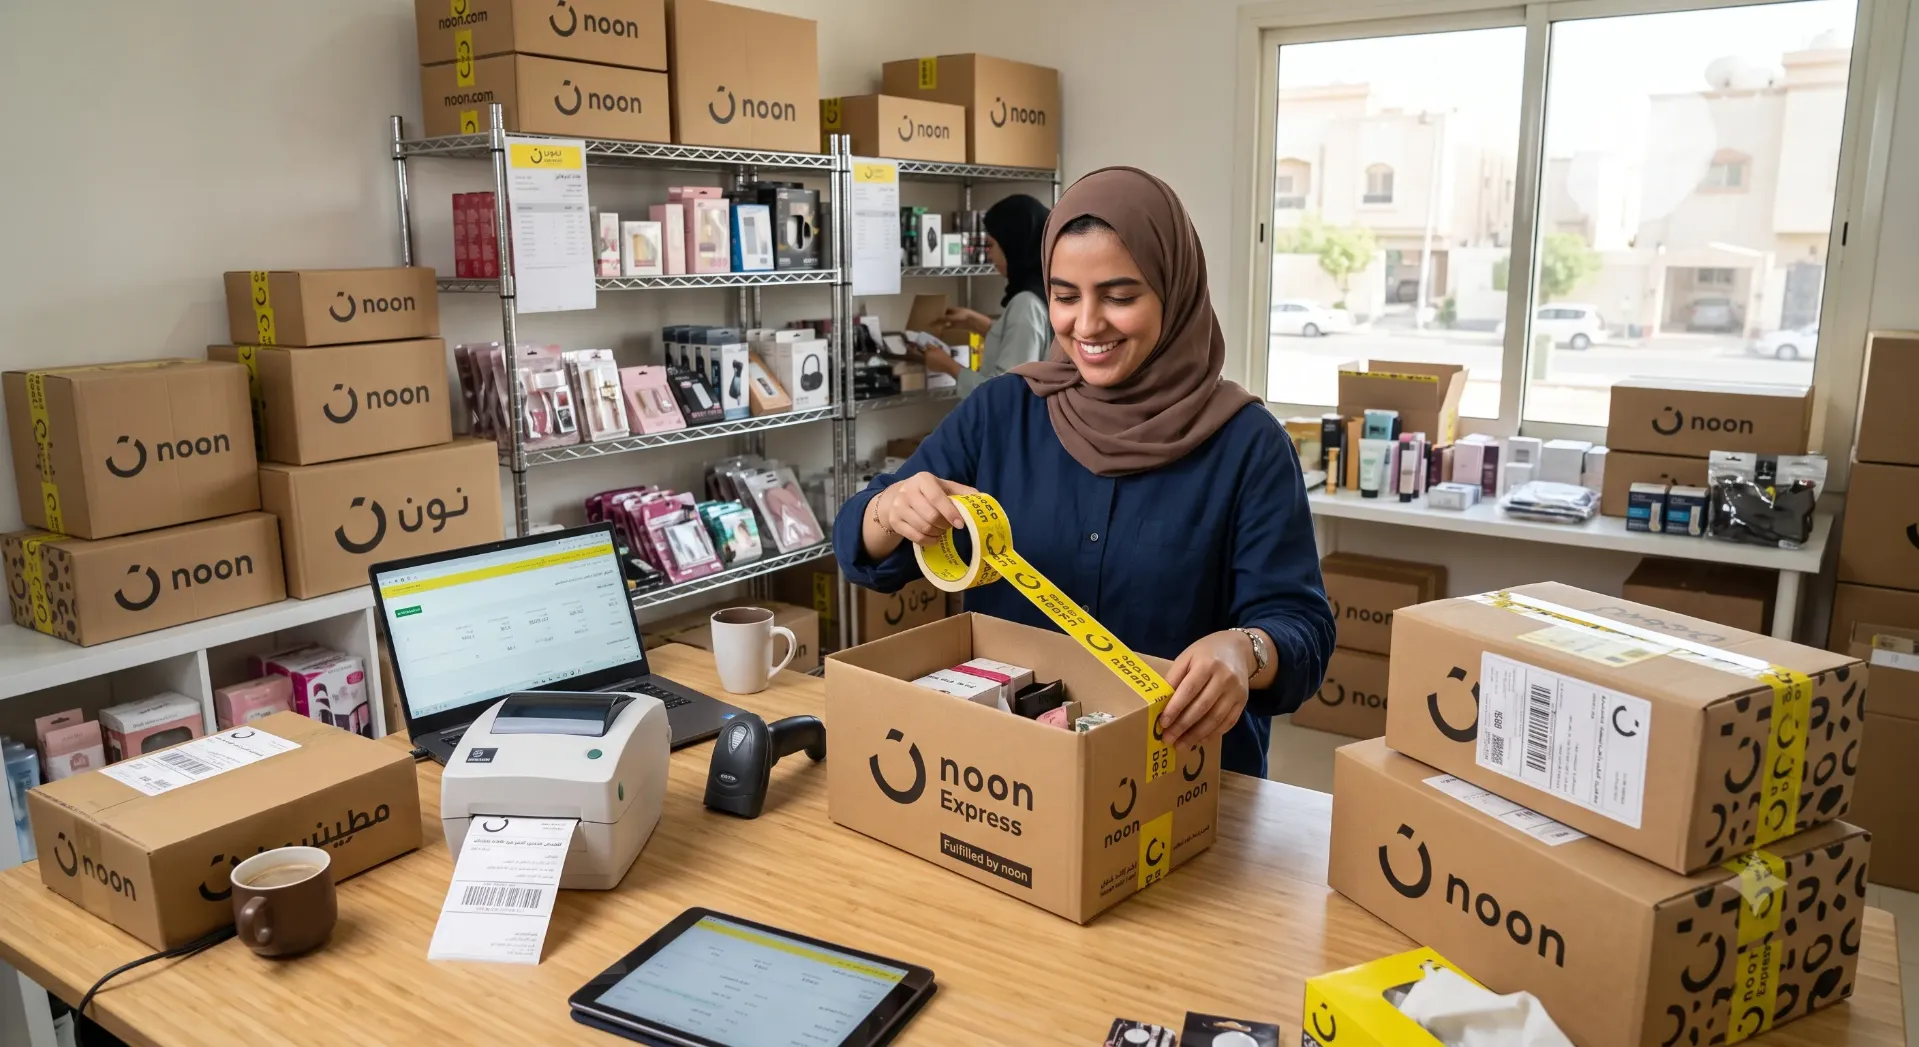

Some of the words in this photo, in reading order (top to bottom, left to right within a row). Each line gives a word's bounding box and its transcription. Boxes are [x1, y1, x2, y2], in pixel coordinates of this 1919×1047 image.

[438, 10, 488, 30] noon.com
[583, 13, 639, 39] noon
[444, 90, 494, 107] noon.com
[588, 91, 642, 114] noon
[742, 98, 796, 122] noon
[1010, 106, 1046, 127] noon
[917, 123, 950, 139] noon
[363, 295, 416, 314] noon
[366, 384, 430, 410] noon
[1691, 416, 1753, 435] noon
[156, 433, 230, 462] noon
[398, 487, 469, 533] نون
[171, 554, 253, 590] noon
[1352, 690, 1388, 710] no
[940, 756, 1034, 812] noon
[1176, 781, 1208, 808] noon
[940, 788, 1022, 837] Express
[1104, 820, 1140, 849] noon
[943, 839, 984, 865] Fulfilled
[986, 855, 999, 872] by
[1001, 862, 1029, 882] noon
[82, 854, 137, 902] noon
[1446, 872, 1565, 969] noon
